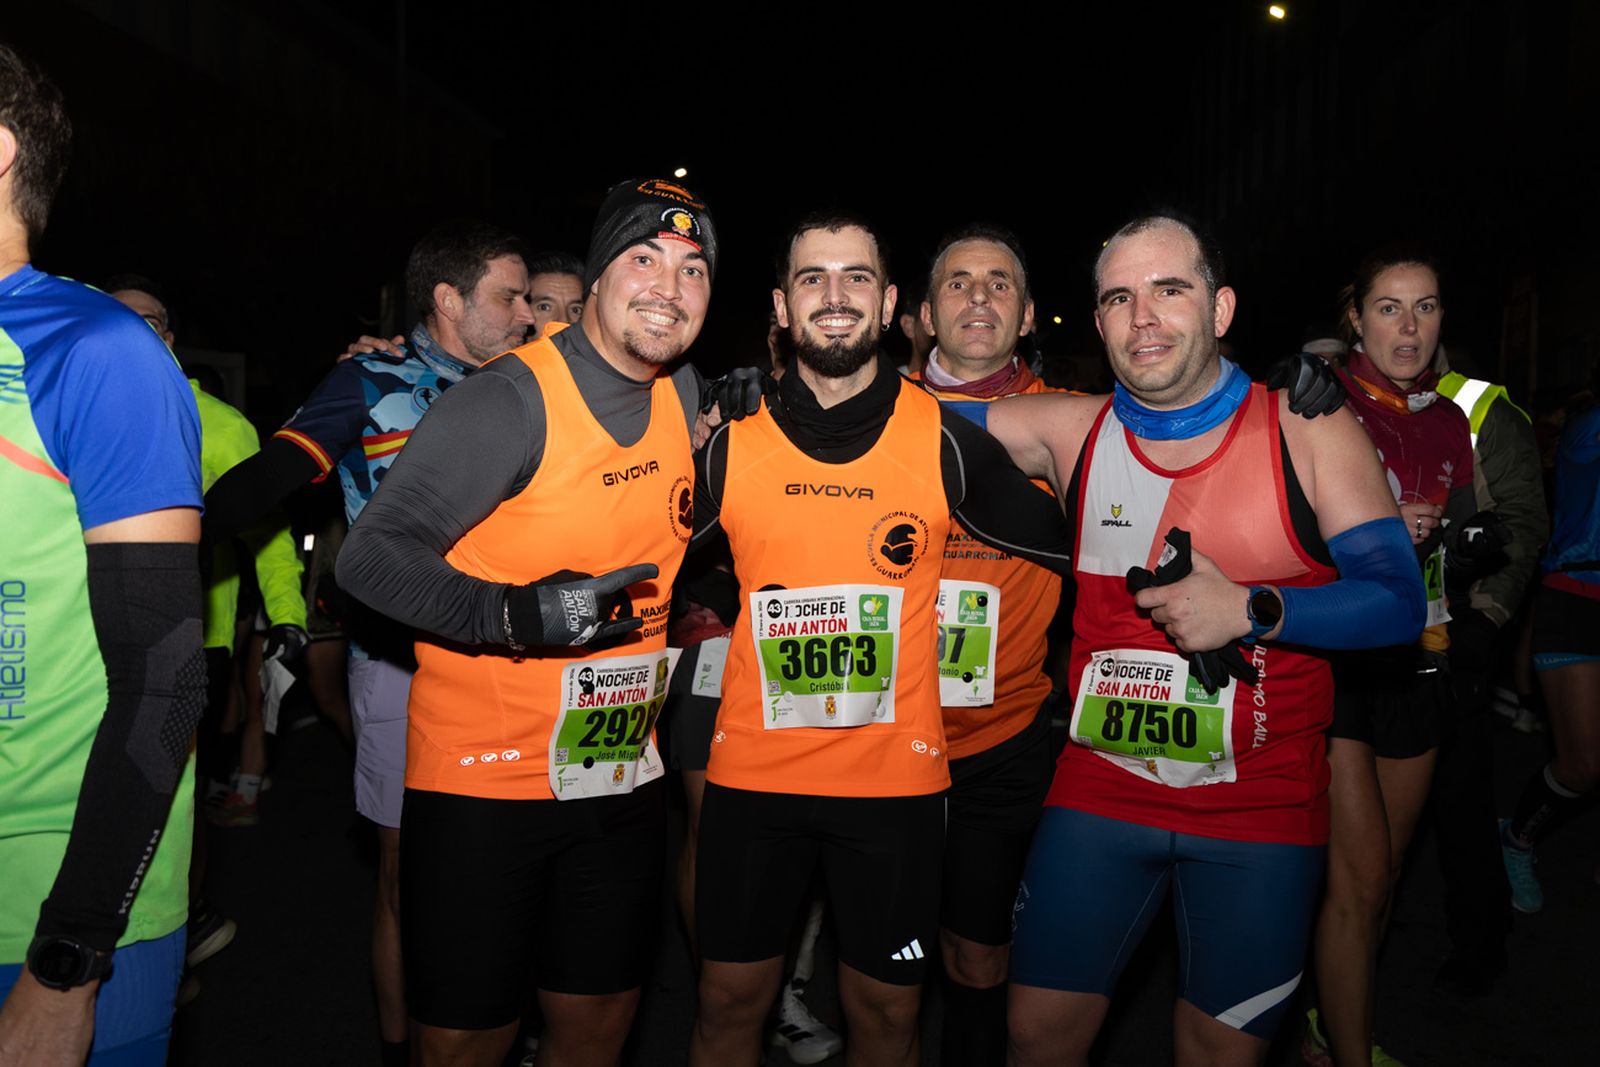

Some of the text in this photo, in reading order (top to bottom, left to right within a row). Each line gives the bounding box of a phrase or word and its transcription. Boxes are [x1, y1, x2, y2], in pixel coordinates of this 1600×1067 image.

[603, 460, 660, 486] GIVOVA
[785, 483, 874, 500] GIVOVA
[1426, 558, 1437, 589] 2
[561, 589, 580, 633] ANTÓN
[572, 589, 589, 617] SAN
[767, 602, 782, 614] 43
[830, 601, 846, 614] DE
[768, 615, 848, 637] SAN ANTÓN
[778, 635, 877, 681] 3663
[579, 670, 594, 683] 43
[1101, 662, 1114, 674] 43
[1113, 664, 1174, 682] NOCHE DE
[595, 670, 650, 688] NOCHE DE
[578, 691, 607, 708] SAN
[607, 684, 648, 706] ANTÓN
[1096, 681, 1172, 701] SAN ANTÓN
[1101, 700, 1198, 749] 8750
[595, 750, 616, 760] José
[1132, 745, 1167, 757] JAVIER
